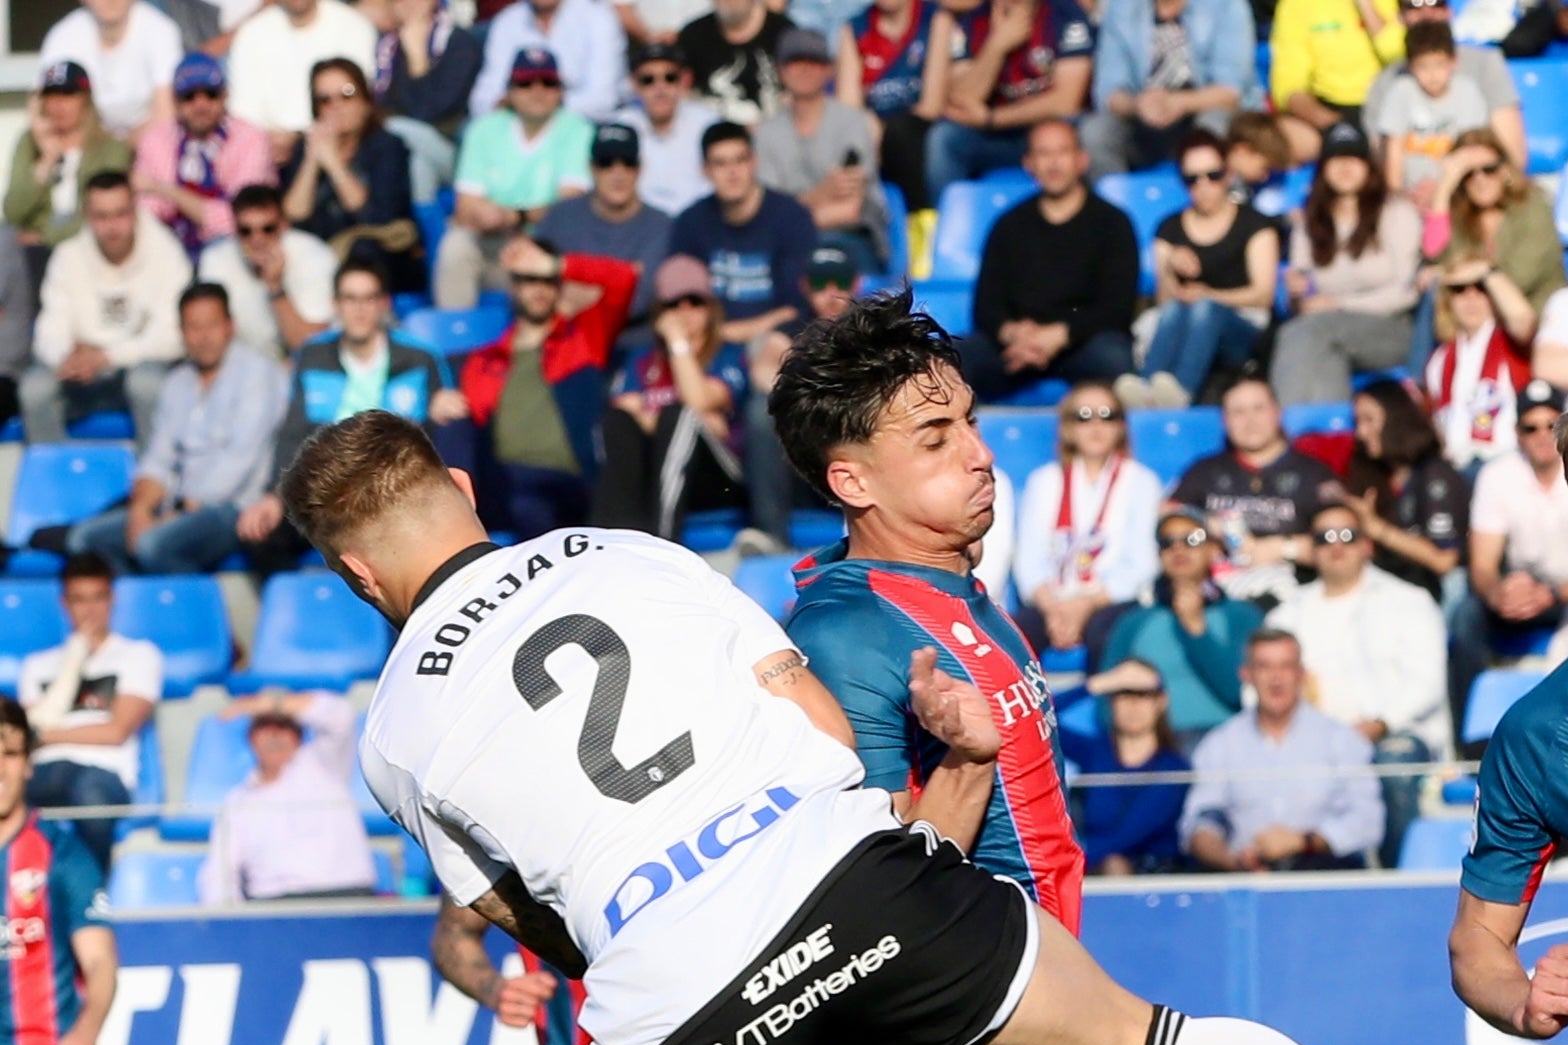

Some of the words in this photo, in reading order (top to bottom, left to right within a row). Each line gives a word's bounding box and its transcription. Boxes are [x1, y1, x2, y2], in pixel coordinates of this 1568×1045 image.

[416, 553, 553, 676] BORJA
[563, 533, 604, 558] G.
[512, 613, 696, 805] 2
[603, 786, 803, 939] DIGI
[741, 924, 835, 1006] EXIDE
